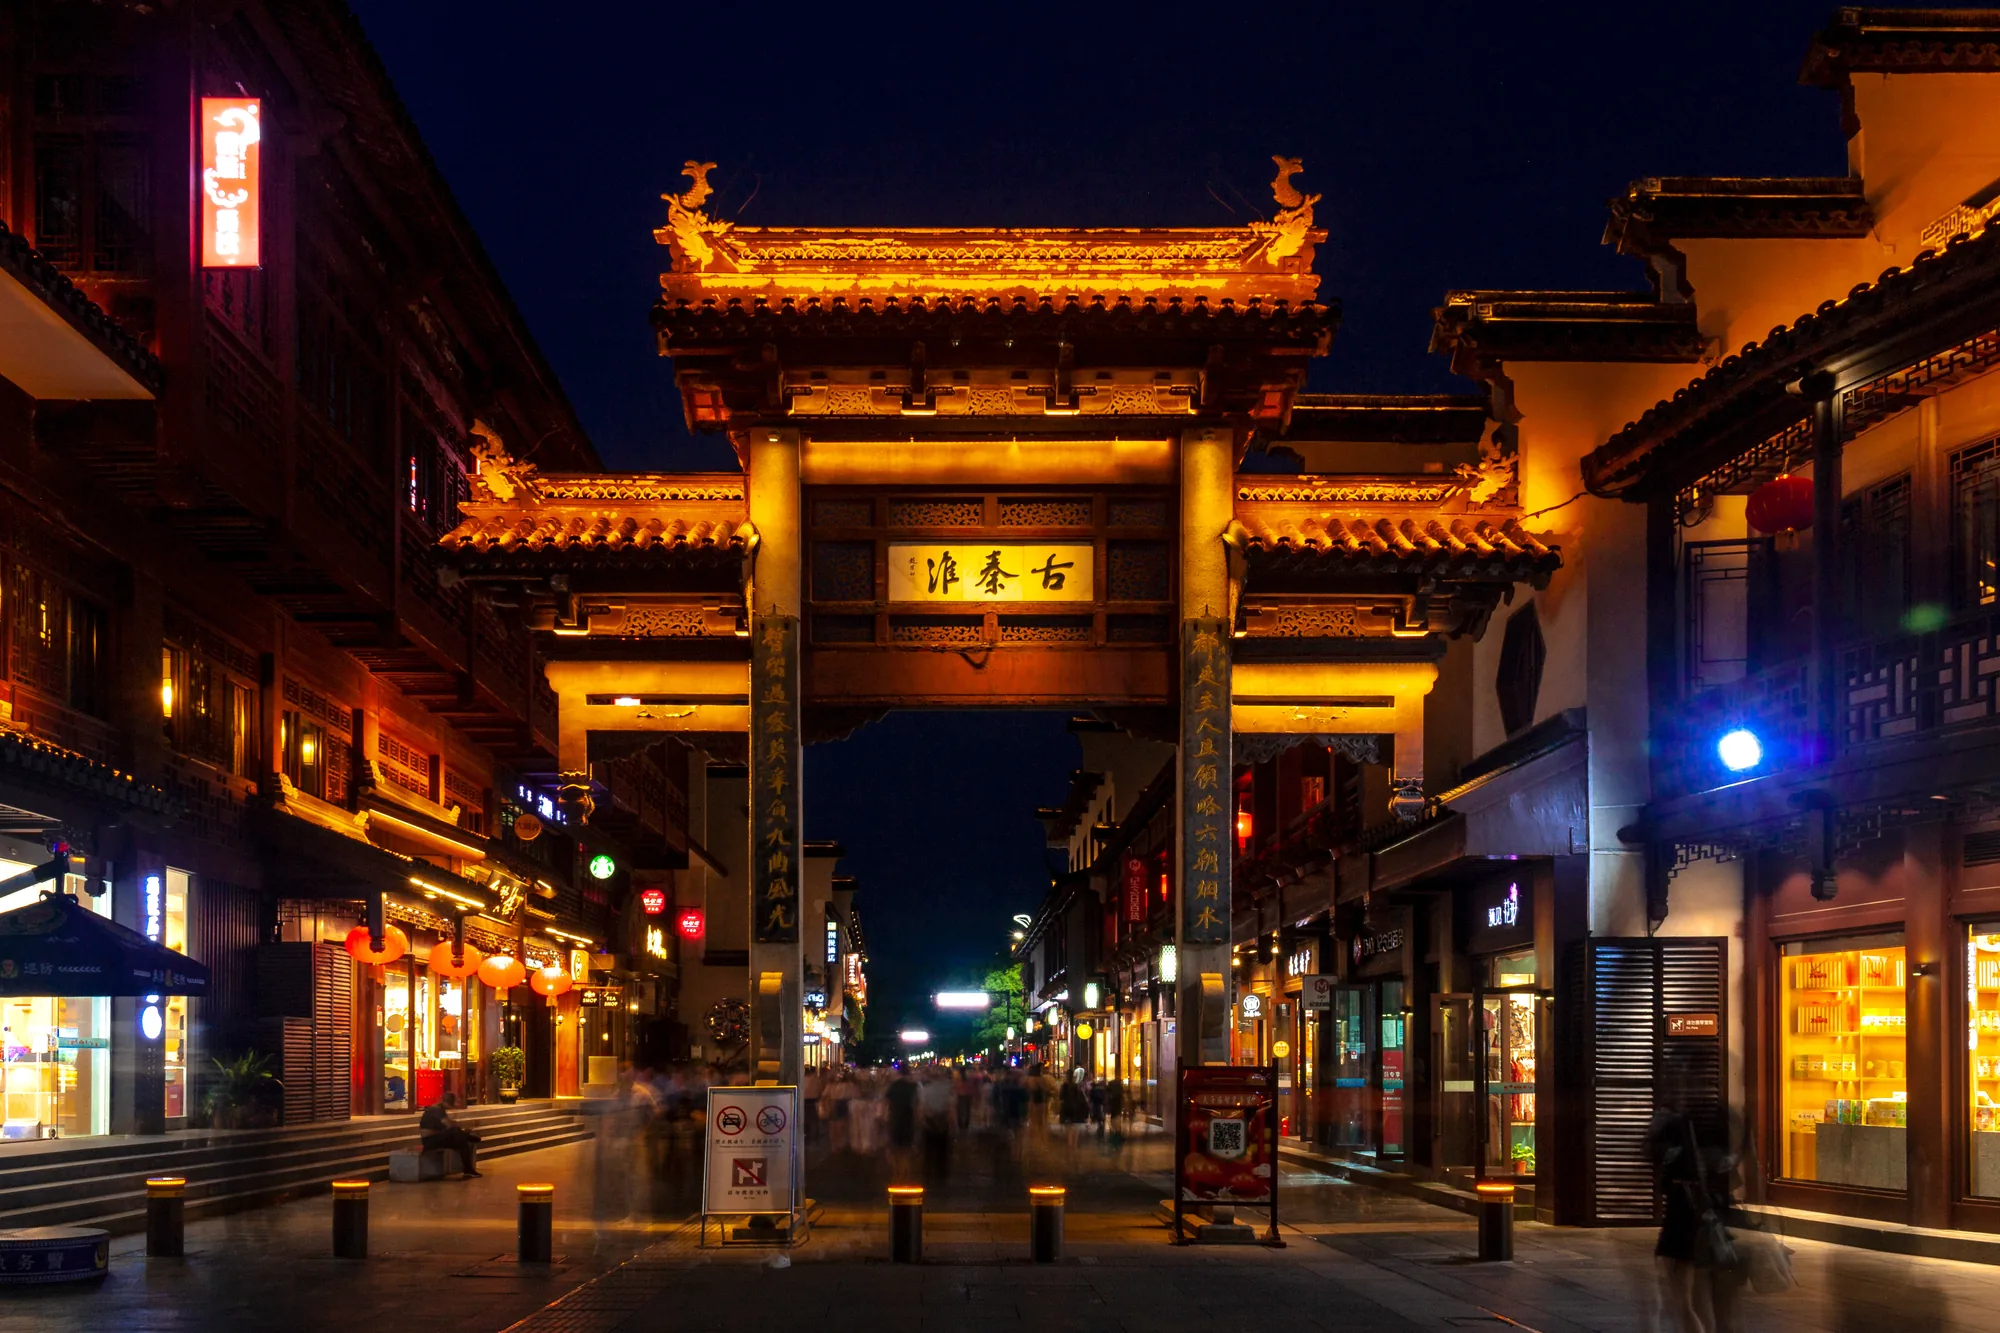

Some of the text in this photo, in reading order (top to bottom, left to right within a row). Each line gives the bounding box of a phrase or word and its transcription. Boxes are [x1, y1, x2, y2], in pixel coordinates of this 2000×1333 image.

[926, 549, 1075, 596] 古秦淮
[23, 961, 54, 976] 巡防
